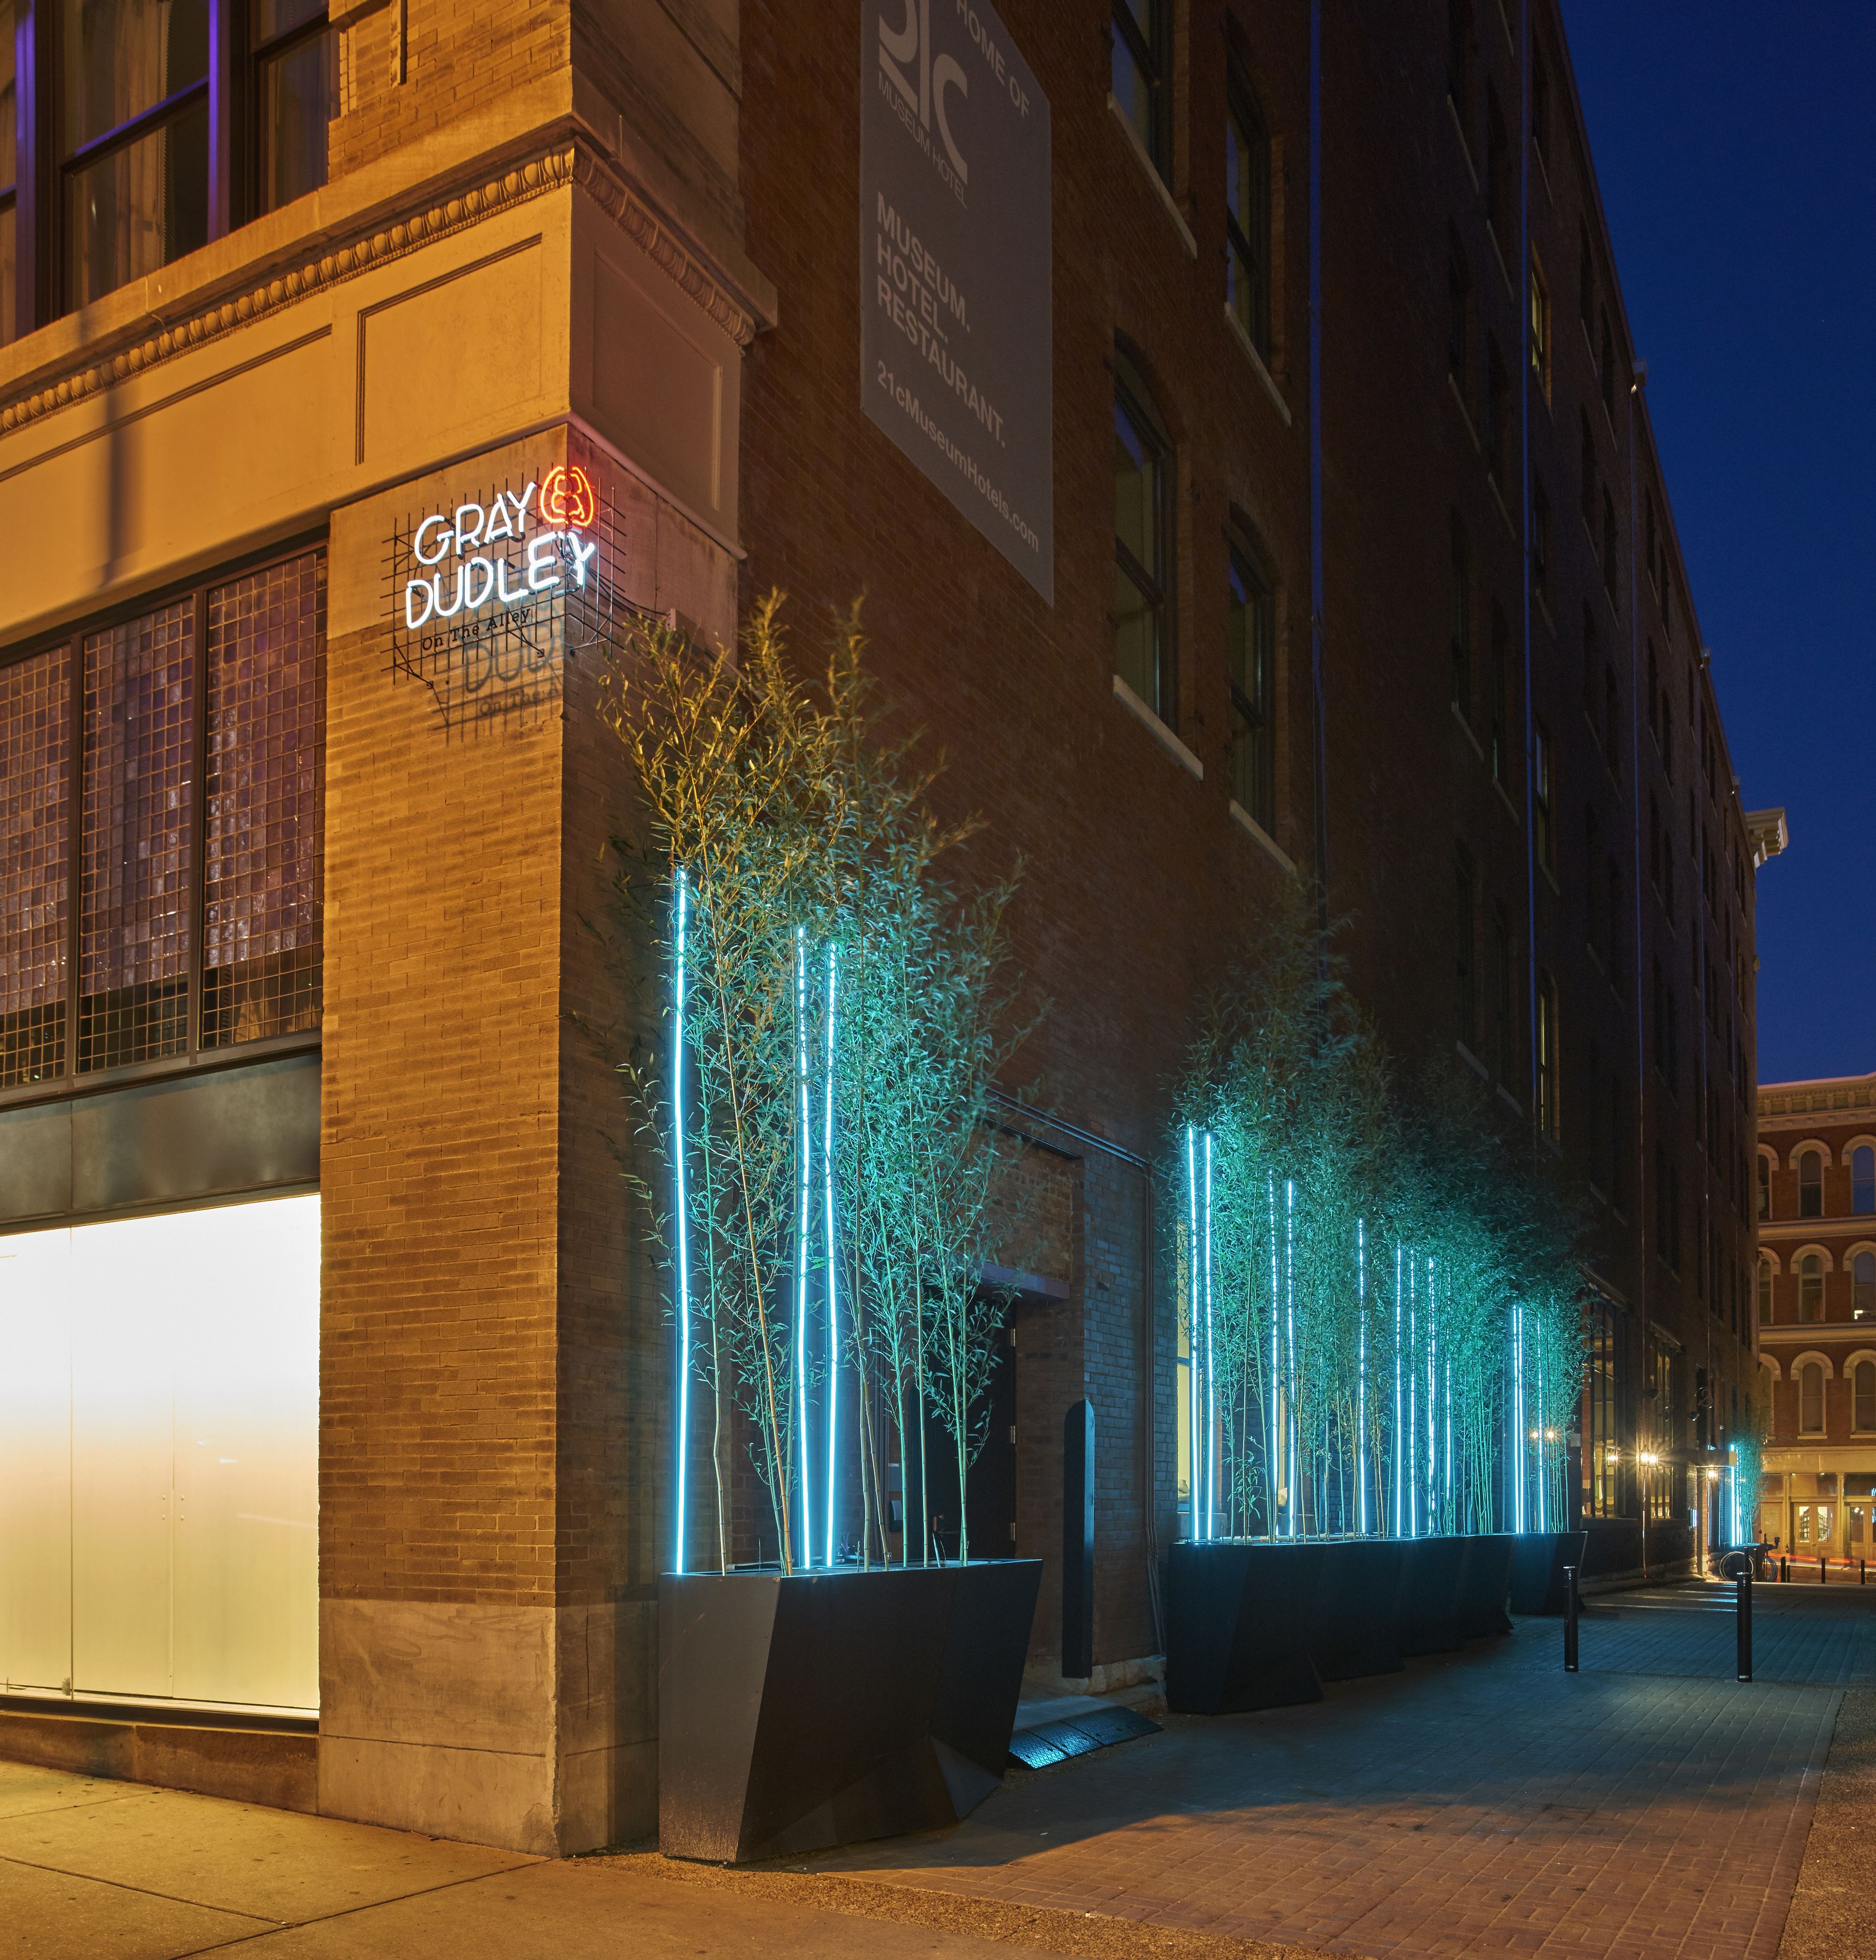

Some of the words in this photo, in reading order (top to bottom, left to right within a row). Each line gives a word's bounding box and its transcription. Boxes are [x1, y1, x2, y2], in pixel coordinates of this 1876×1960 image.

[879, 70, 930, 158] MUSEUM
[932, 146, 968, 210] HOTEL
[1009, 76, 1030, 117] OF
[877, 191, 971, 333] MUSEUM.
[877, 233, 949, 344] HOTEL.
[877, 275, 1006, 448] RESTAURANT.
[877, 360, 1039, 552] 21cMuseumHotels.com
[414, 481, 537, 565] GRAY
[406, 531, 595, 629] DUDLEY
[422, 635, 443, 651] On
[450, 623, 479, 642] The
[486, 608, 531, 631] Alley
